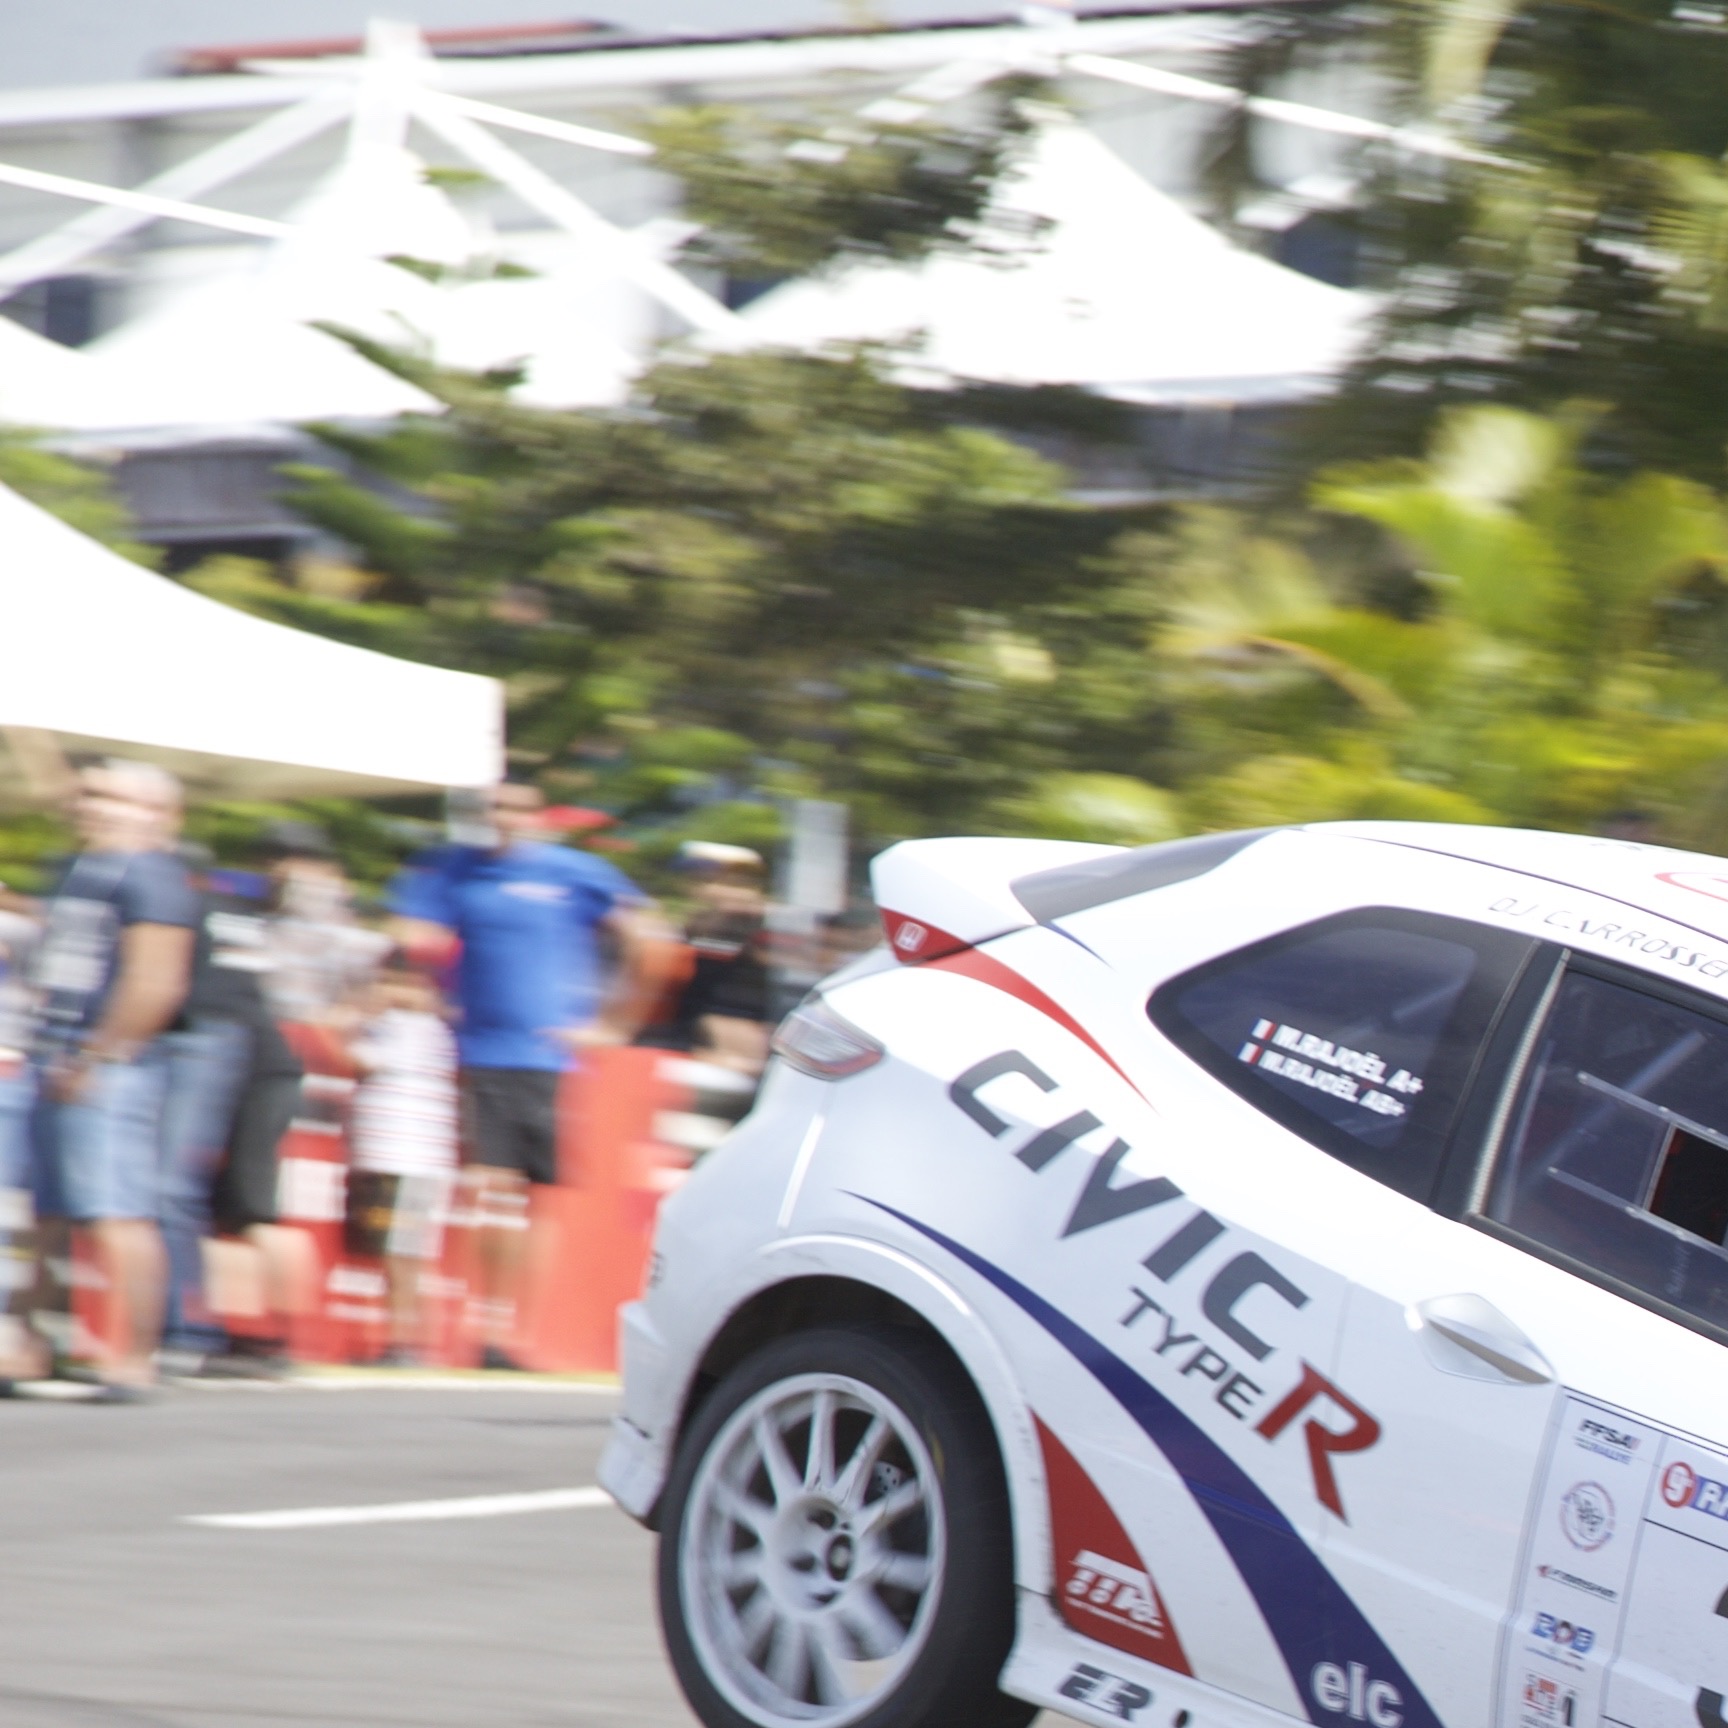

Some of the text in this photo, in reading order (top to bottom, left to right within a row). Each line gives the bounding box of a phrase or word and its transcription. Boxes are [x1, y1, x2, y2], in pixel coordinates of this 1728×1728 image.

[948, 1049, 1312, 1361] CIVIC
[1116, 1286, 1267, 1420] TYPE
[1253, 1357, 1382, 1527] R
